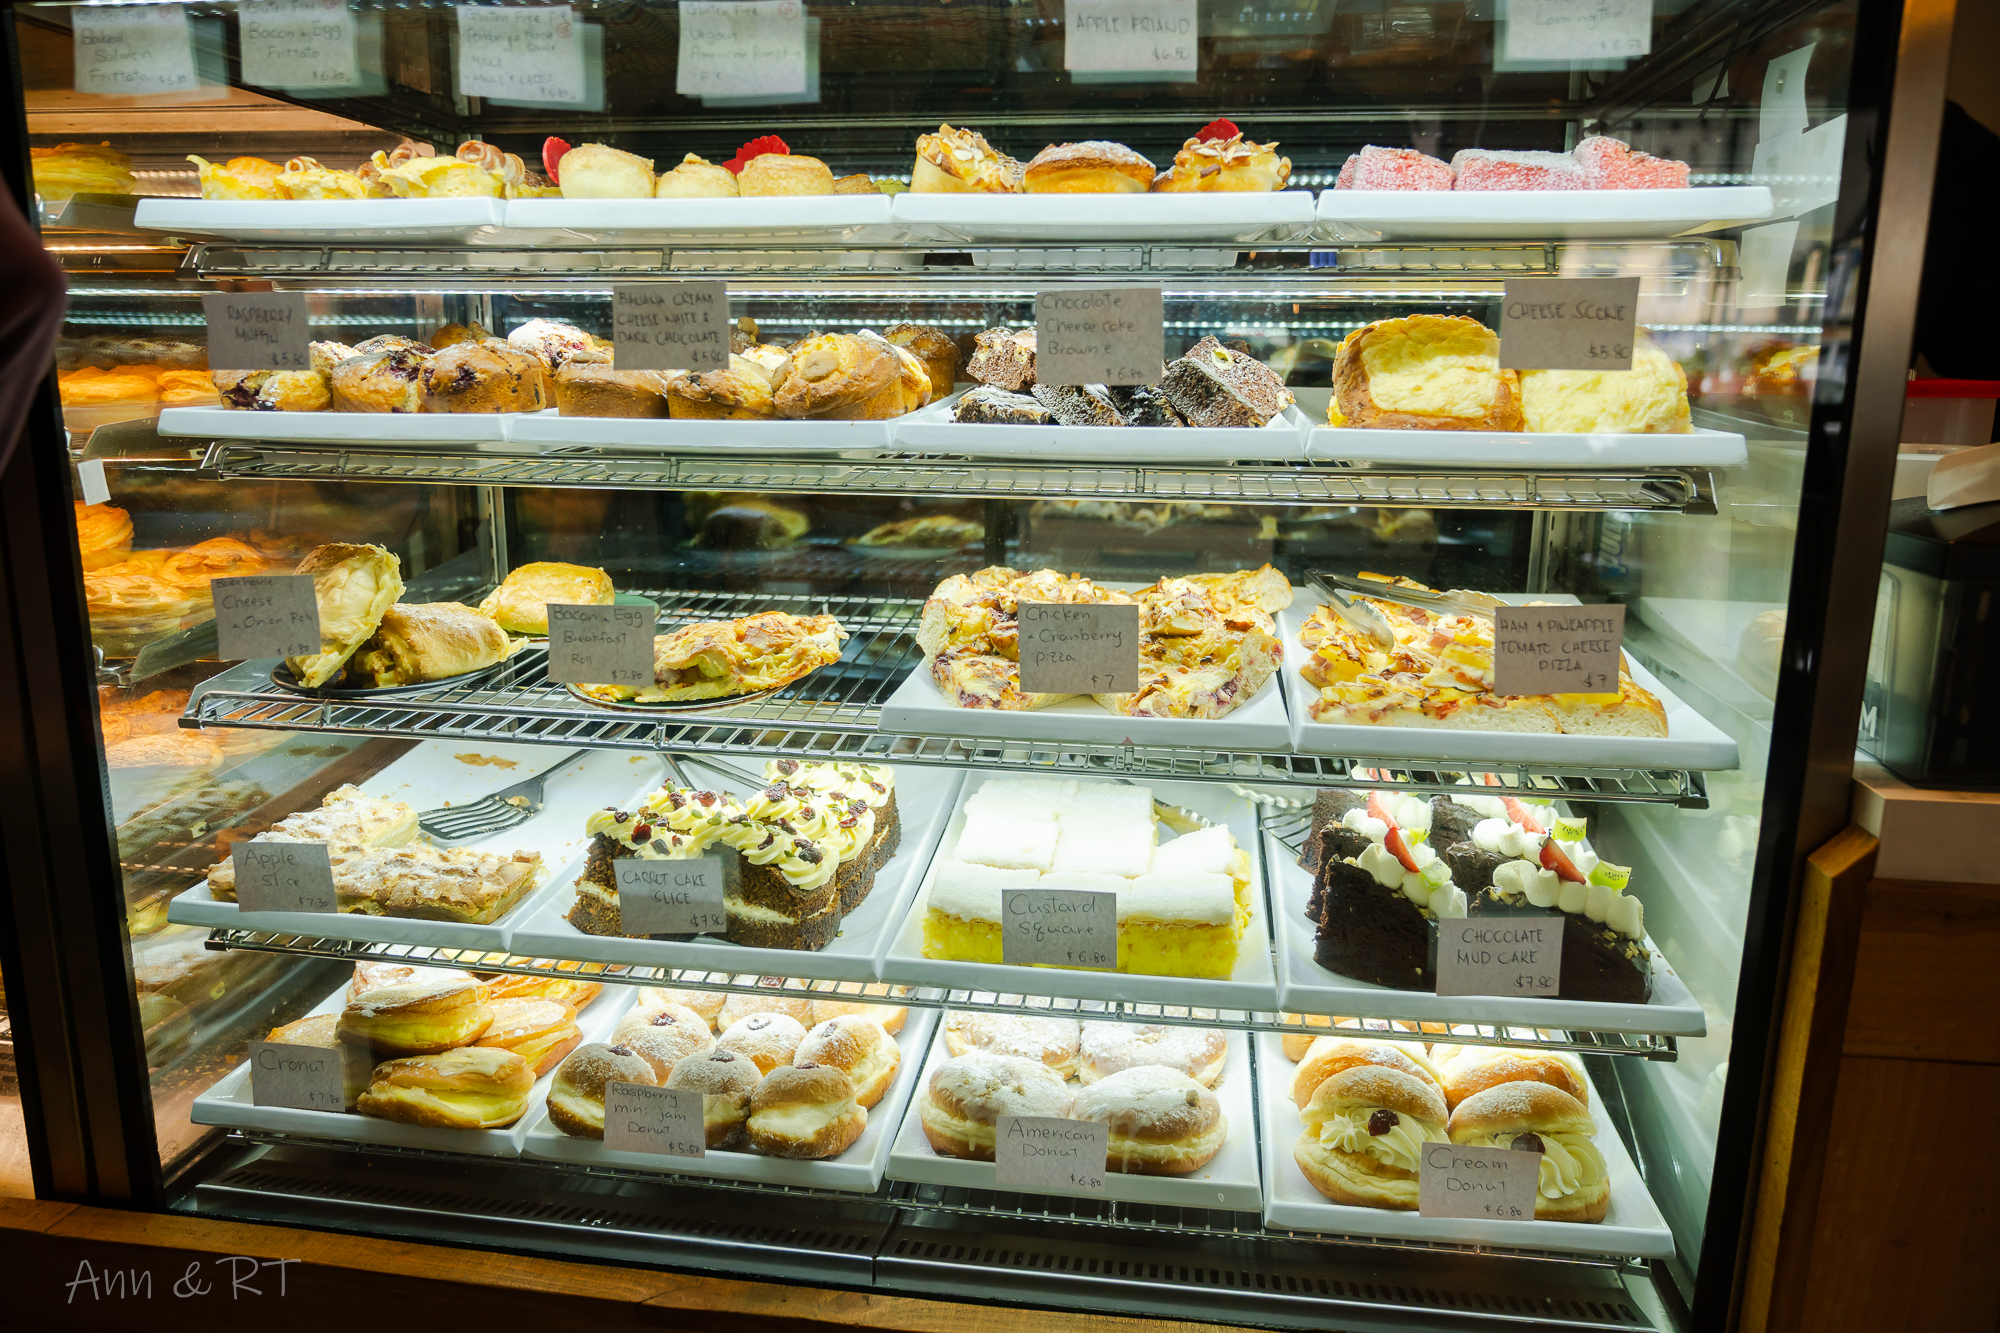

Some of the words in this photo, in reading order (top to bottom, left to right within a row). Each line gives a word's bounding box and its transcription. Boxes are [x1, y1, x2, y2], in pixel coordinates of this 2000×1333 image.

[467, 9, 509, 23] Gluten
[515, 10, 541, 24] Free
[686, 3, 729, 17] Gluten
[734, 4, 760, 17] Free
[249, 21, 295, 40] Bacon
[312, 20, 342, 41] Egg
[1076, 12, 1120, 33] APPLE
[1131, 14, 1190, 36] FRIAND
[82, 28, 124, 45] Baked
[673, 291, 714, 307] CREAM
[1040, 292, 1122, 310] Chocolate
[227, 305, 292, 326] RASPBERRY
[1506, 302, 1565, 320] CHEESE
[1572, 300, 1626, 321] SCONE
[617, 312, 660, 327] CHEESE
[664, 312, 698, 325] WHITE
[618, 331, 651, 344] DARK
[655, 331, 720, 346] CHOCOLATE
[1047, 341, 1112, 356] Brownie
[221, 595, 275, 610] Cheese
[553, 604, 598, 622] Bacon
[613, 608, 644, 629] Egg
[1026, 604, 1091, 621] Chicken
[243, 615, 284, 629] Onion
[1500, 617, 1529, 633] HAM
[1546, 616, 1615, 633] PINEAPPLE
[564, 630, 628, 644] Breakfast
[1039, 628, 1122, 648] Cranberry
[1500, 640, 1550, 655] TOMATO
[1561, 639, 1612, 654] CHEESE
[571, 653, 593, 665] Roll
[1538, 658, 1582, 671] PIZZA
[611, 669, 643, 682] $7.80
[244, 848, 296, 869] Apple
[622, 870, 669, 885] CARROT
[674, 872, 706, 887] CAKE
[653, 889, 692, 906] SLICE
[1008, 893, 1096, 915] Custard
[689, 913, 725, 928] $7.80
[1461, 927, 1544, 944] CHOCOLATE
[1066, 950, 1106, 963] $6.80
[1456, 949, 1492, 966] MUD
[1497, 949, 1539, 965] CAKE
[1513, 973, 1556, 989] $7.80
[258, 1049, 325, 1072] Cronut
[308, 1092, 340, 1105] $7.80
[612, 1081, 678, 1109] Raspberry
[657, 1105, 687, 1122] jam
[627, 1121, 671, 1135] Donut
[1007, 1118, 1095, 1141] American
[668, 1141, 700, 1155] $5.50
[1022, 1143, 1079, 1157] Donut
[1428, 1147, 1509, 1170] Cream
[1070, 1173, 1102, 1188] $6.80
[1446, 1177, 1505, 1192] Donut
[1484, 1203, 1523, 1217] $6.80
